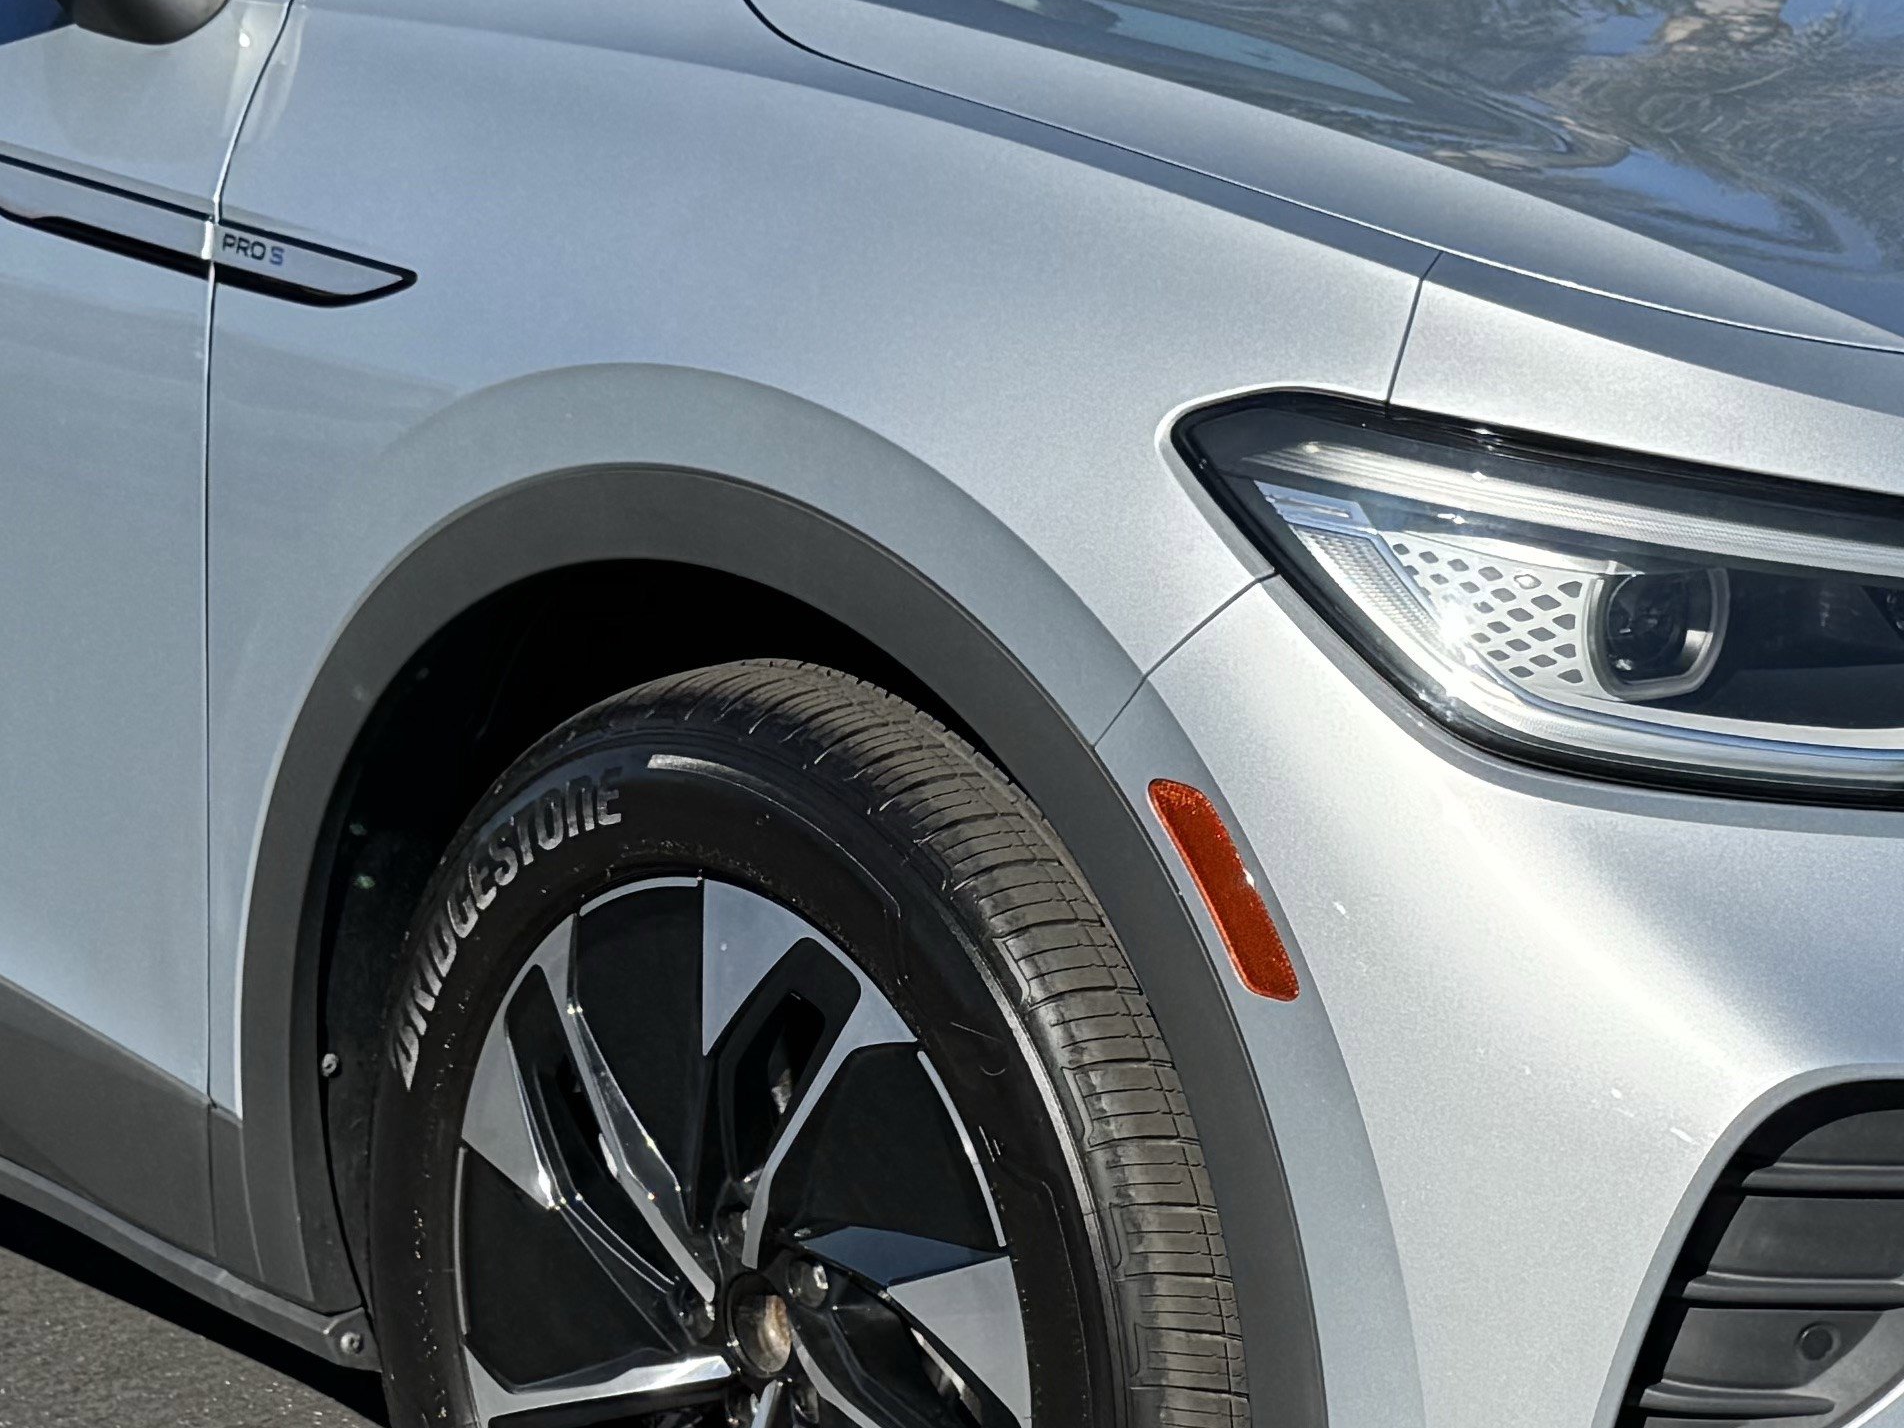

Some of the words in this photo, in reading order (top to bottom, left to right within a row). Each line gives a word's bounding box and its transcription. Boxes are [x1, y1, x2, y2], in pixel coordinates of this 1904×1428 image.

[222, 233, 266, 261] PRO
[270, 245, 285, 266] S
[389, 767, 623, 1091] BRIDGESTONE
